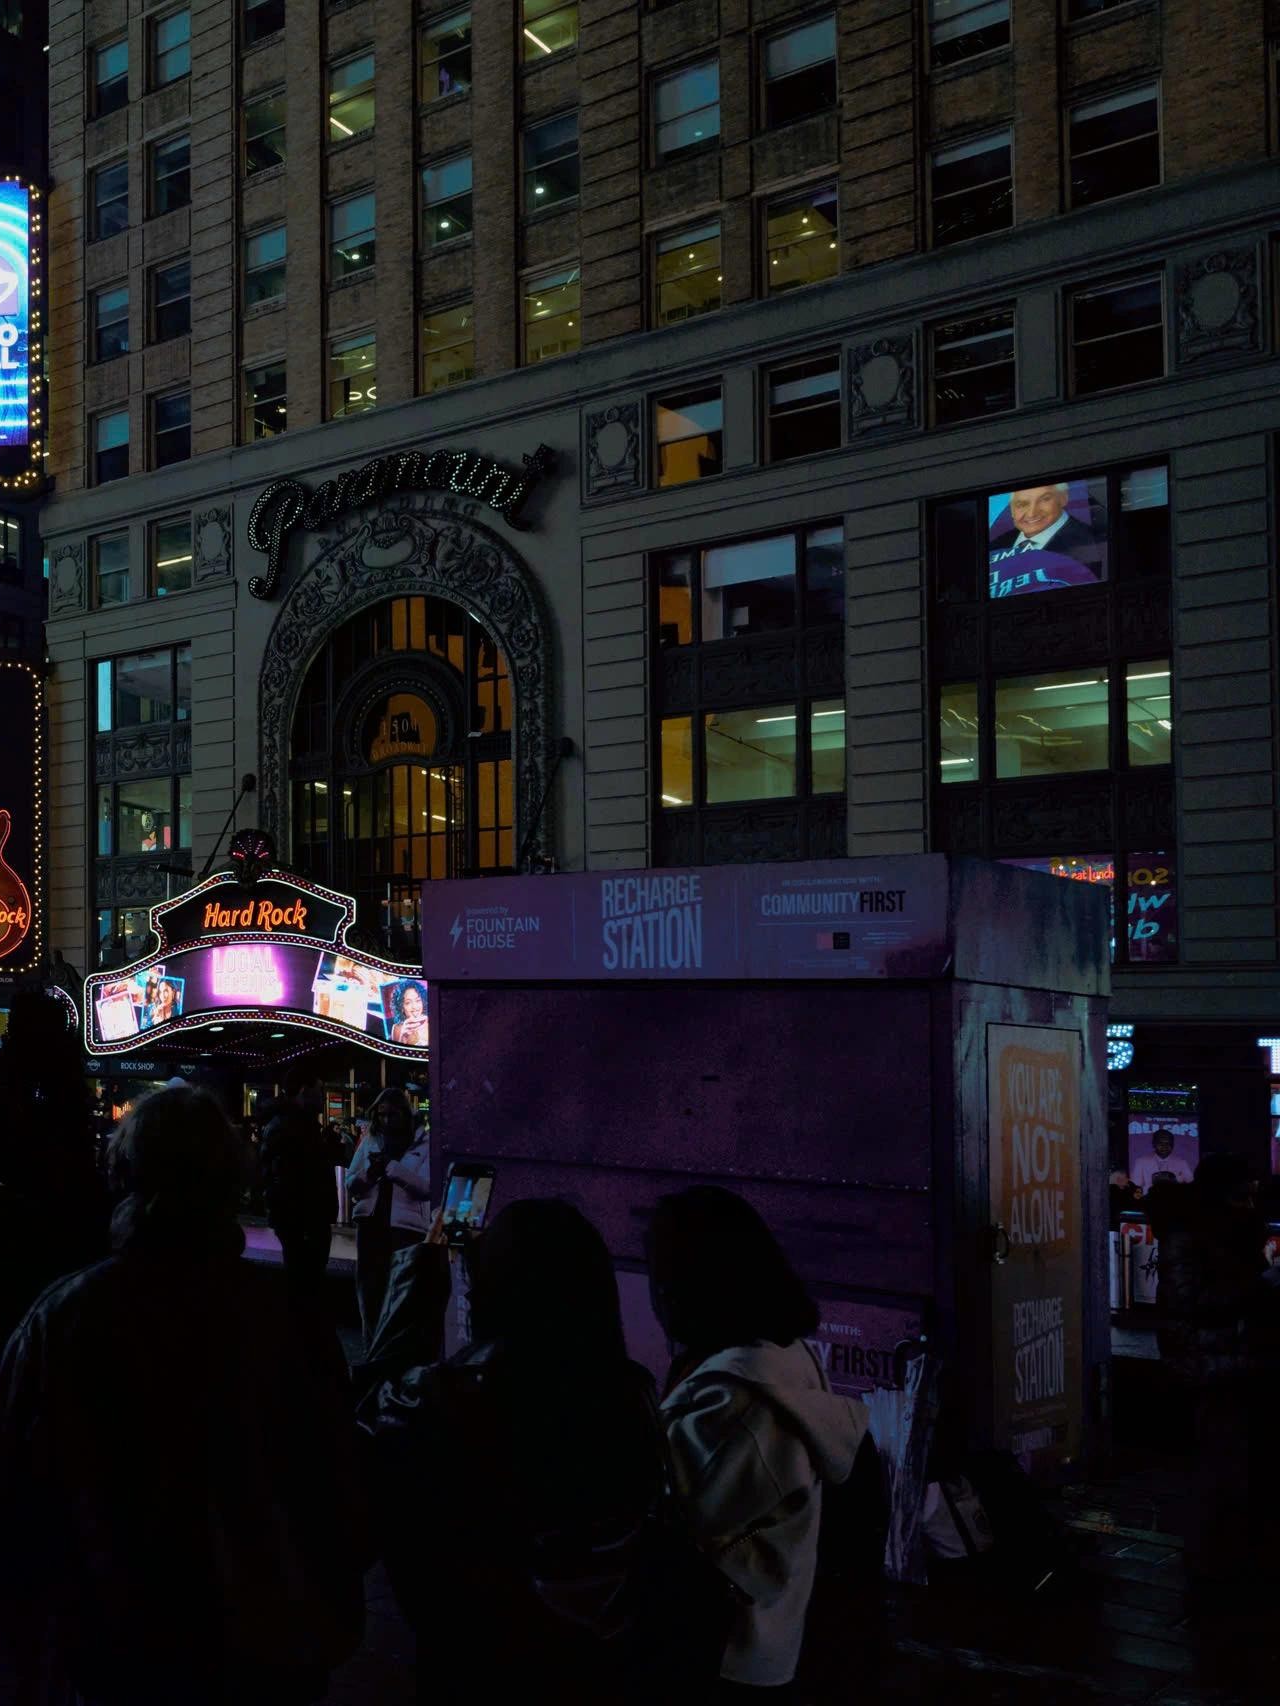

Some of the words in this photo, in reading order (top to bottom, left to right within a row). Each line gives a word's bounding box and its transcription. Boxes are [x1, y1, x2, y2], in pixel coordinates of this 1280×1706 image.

[248, 443, 555, 600] Paramount
[204, 900, 255, 929] Hard
[257, 898, 308, 932] Rock
[601, 875, 703, 919] RECHARGE
[466, 916, 540, 933] FOUNTAIN
[466, 933, 516, 949] HOUSE
[602, 903, 703, 970] STATION
[120, 1062, 137, 1071] ROCK
[138, 1062, 155, 1071] SHOP
[1008, 1063, 1036, 1117] YOU
[1038, 1066, 1063, 1126] ARE
[1012, 1121, 1065, 1190] NOT
[1008, 1190, 1065, 1245] ALONE
[1013, 1297, 1063, 1347] RECHARGE
[1015, 1327, 1065, 1404] STATION
